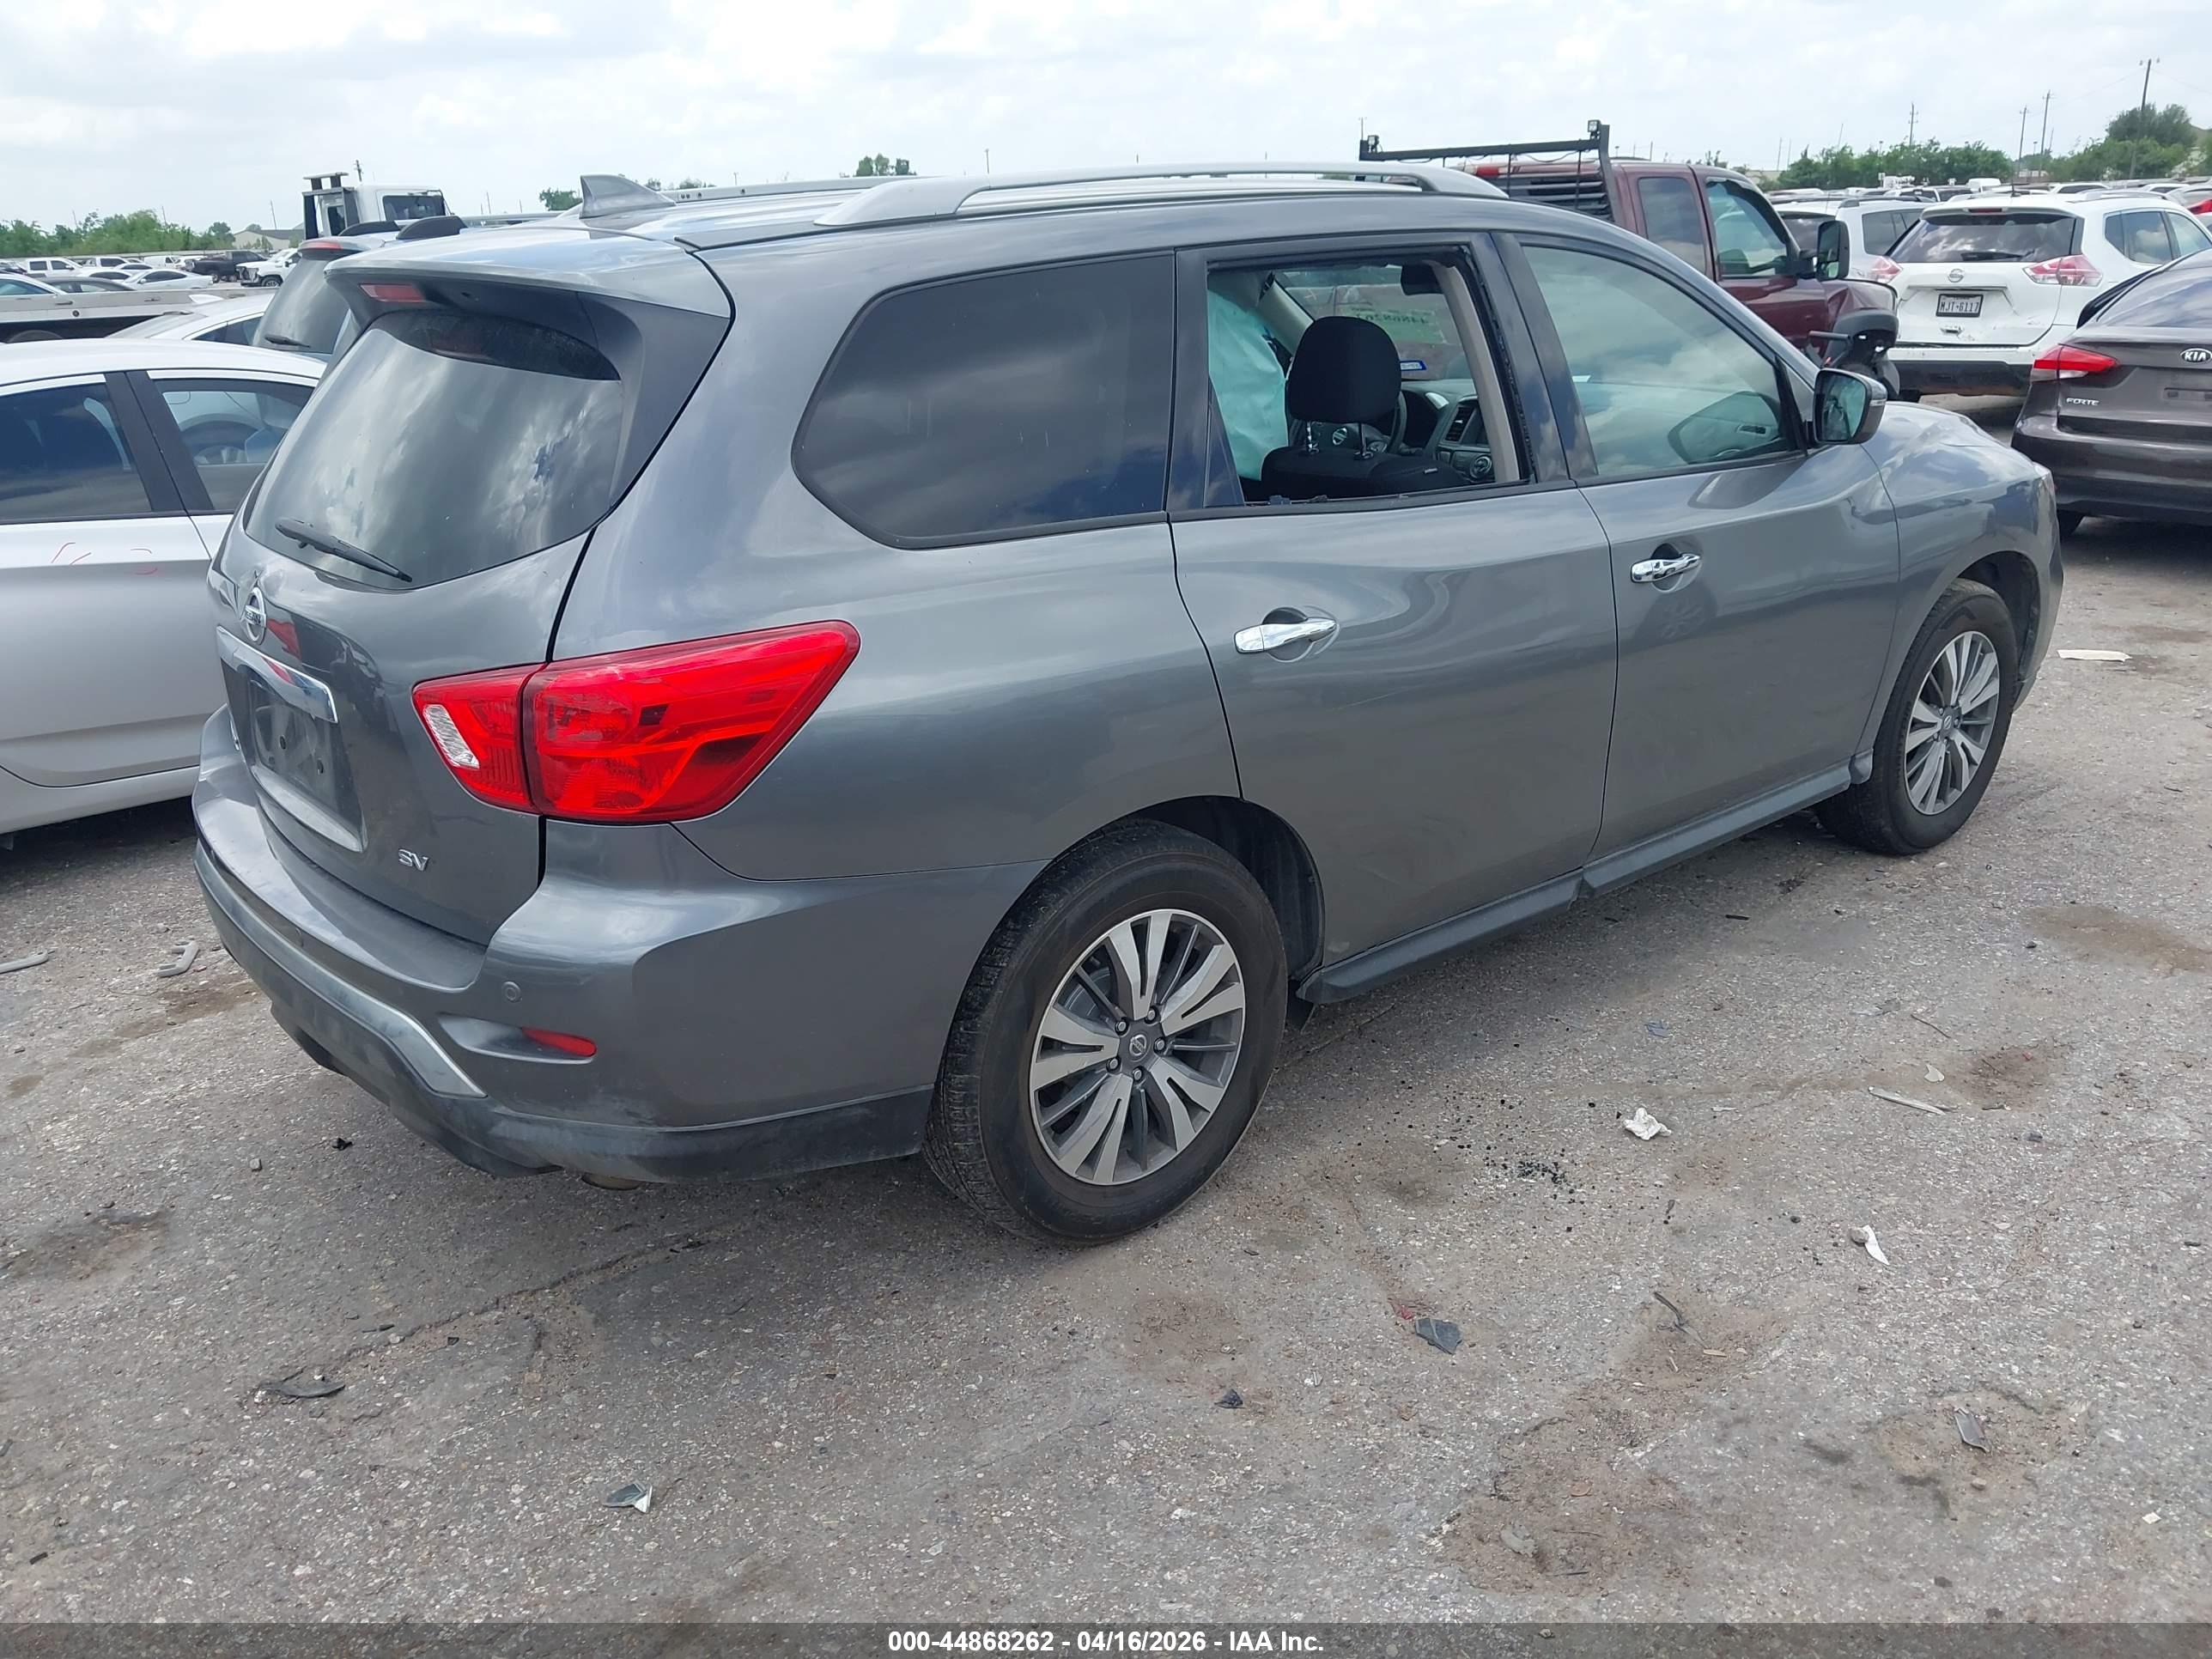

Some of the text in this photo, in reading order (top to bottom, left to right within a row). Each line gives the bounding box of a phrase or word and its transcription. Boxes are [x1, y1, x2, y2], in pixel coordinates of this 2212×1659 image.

[2185, 351, 2206, 362] KIA
[2066, 398, 2100, 406] FORTE
[398, 848, 428, 872] SV
